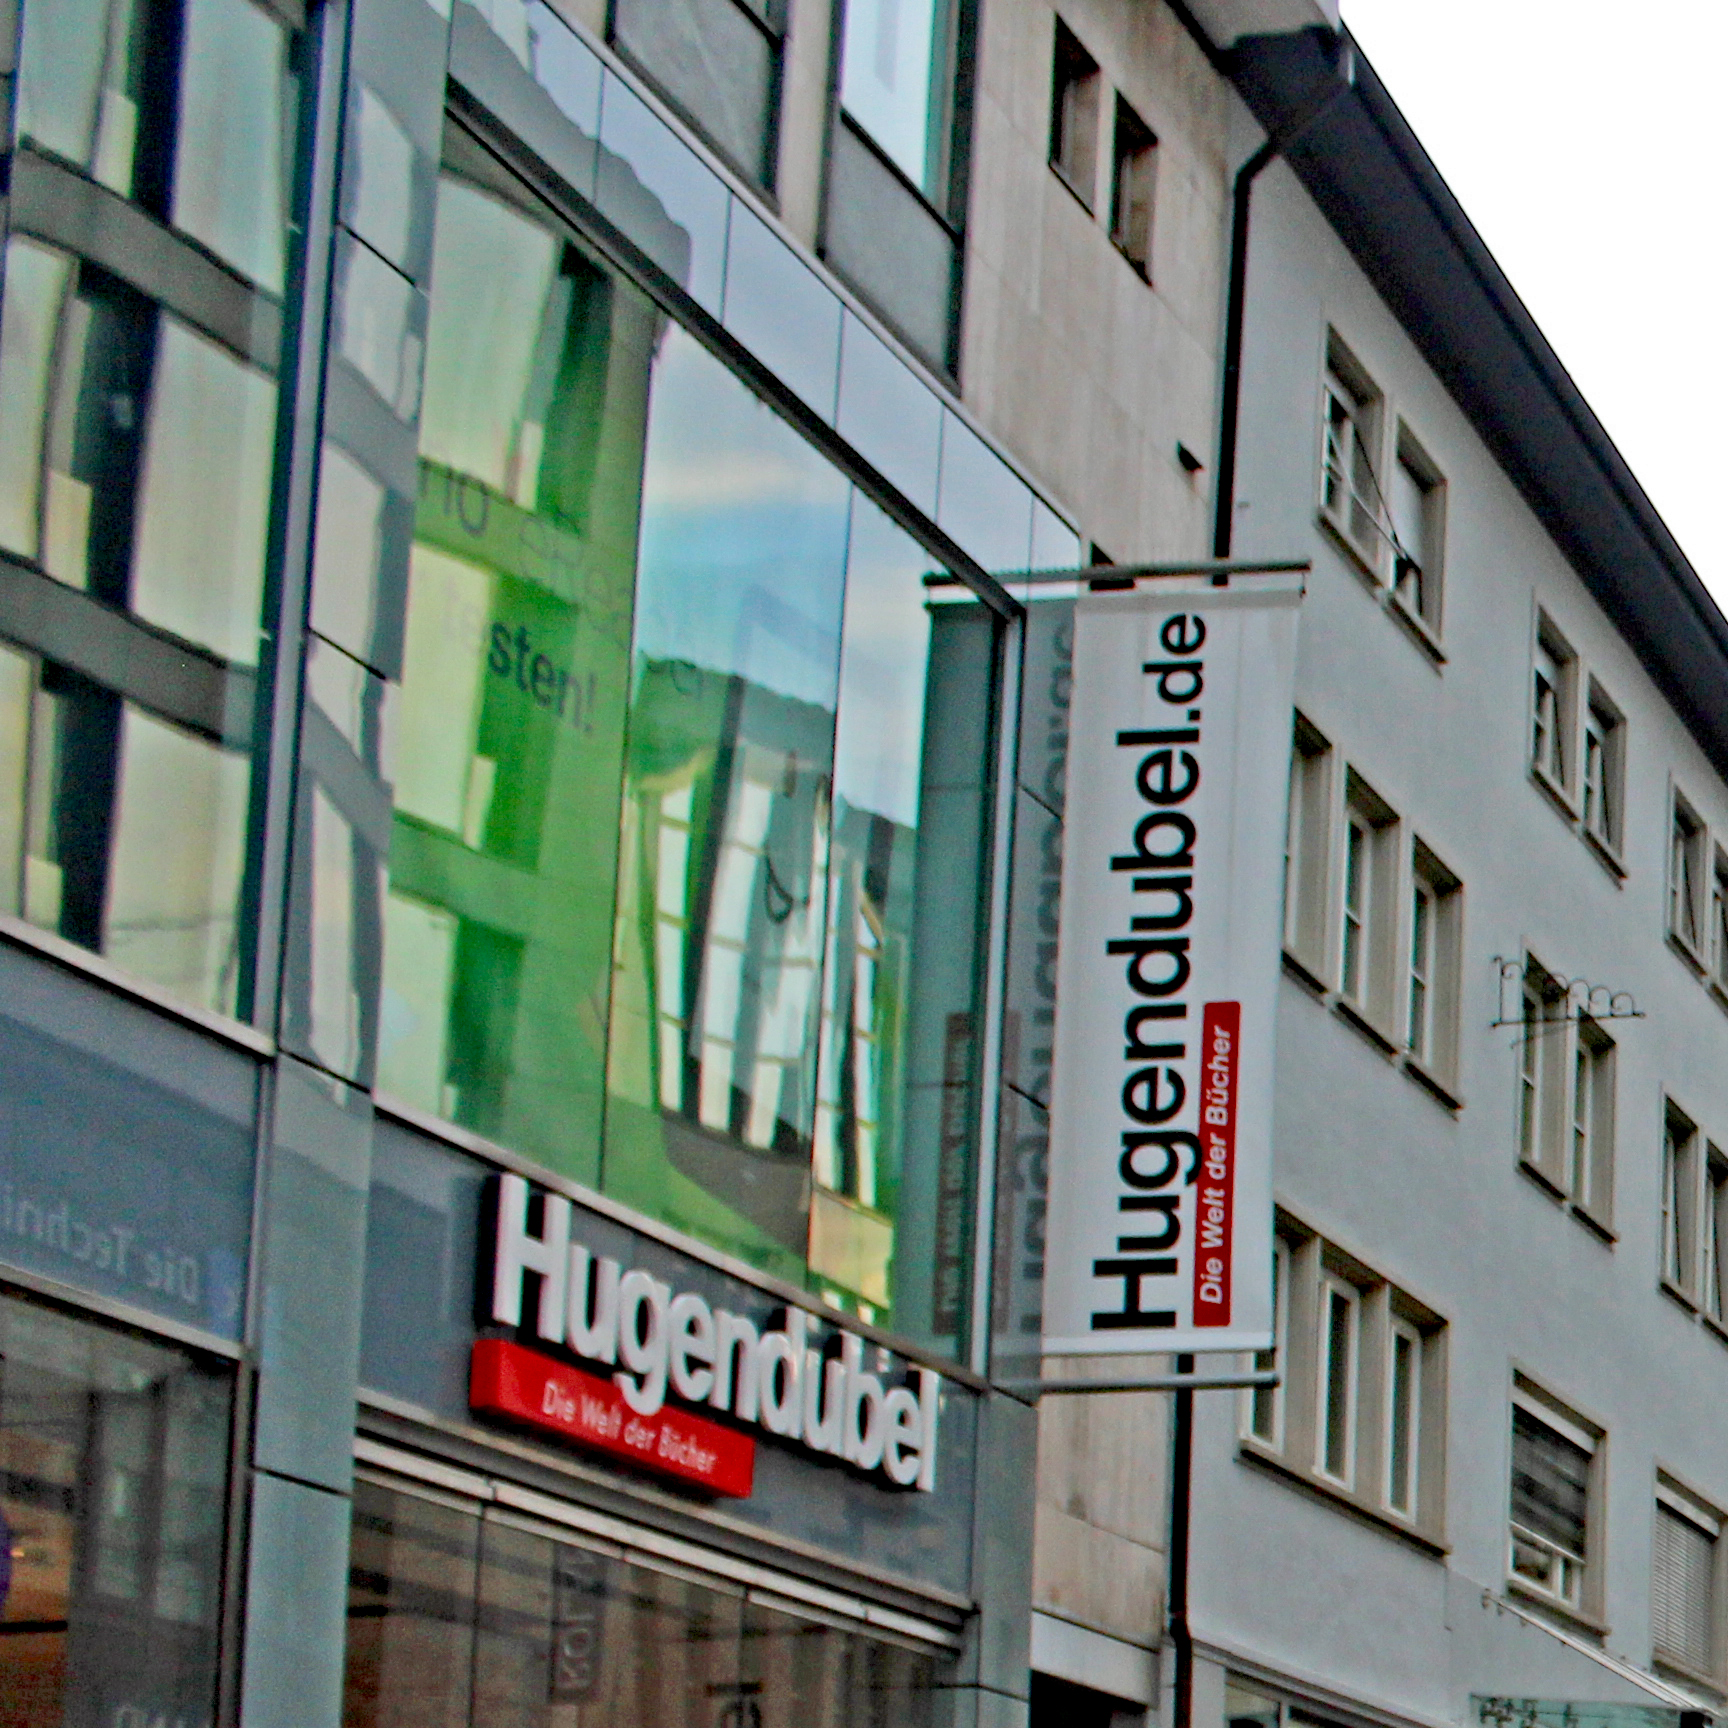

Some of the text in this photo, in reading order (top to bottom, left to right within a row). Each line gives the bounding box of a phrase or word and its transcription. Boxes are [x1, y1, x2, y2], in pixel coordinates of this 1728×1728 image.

[1090, 611, 1208, 1331] Hugendubel.de
[1200, 1024, 1231, 1305] Die Welt der Bücher
[491, 1172, 940, 1493] Hugendubel
